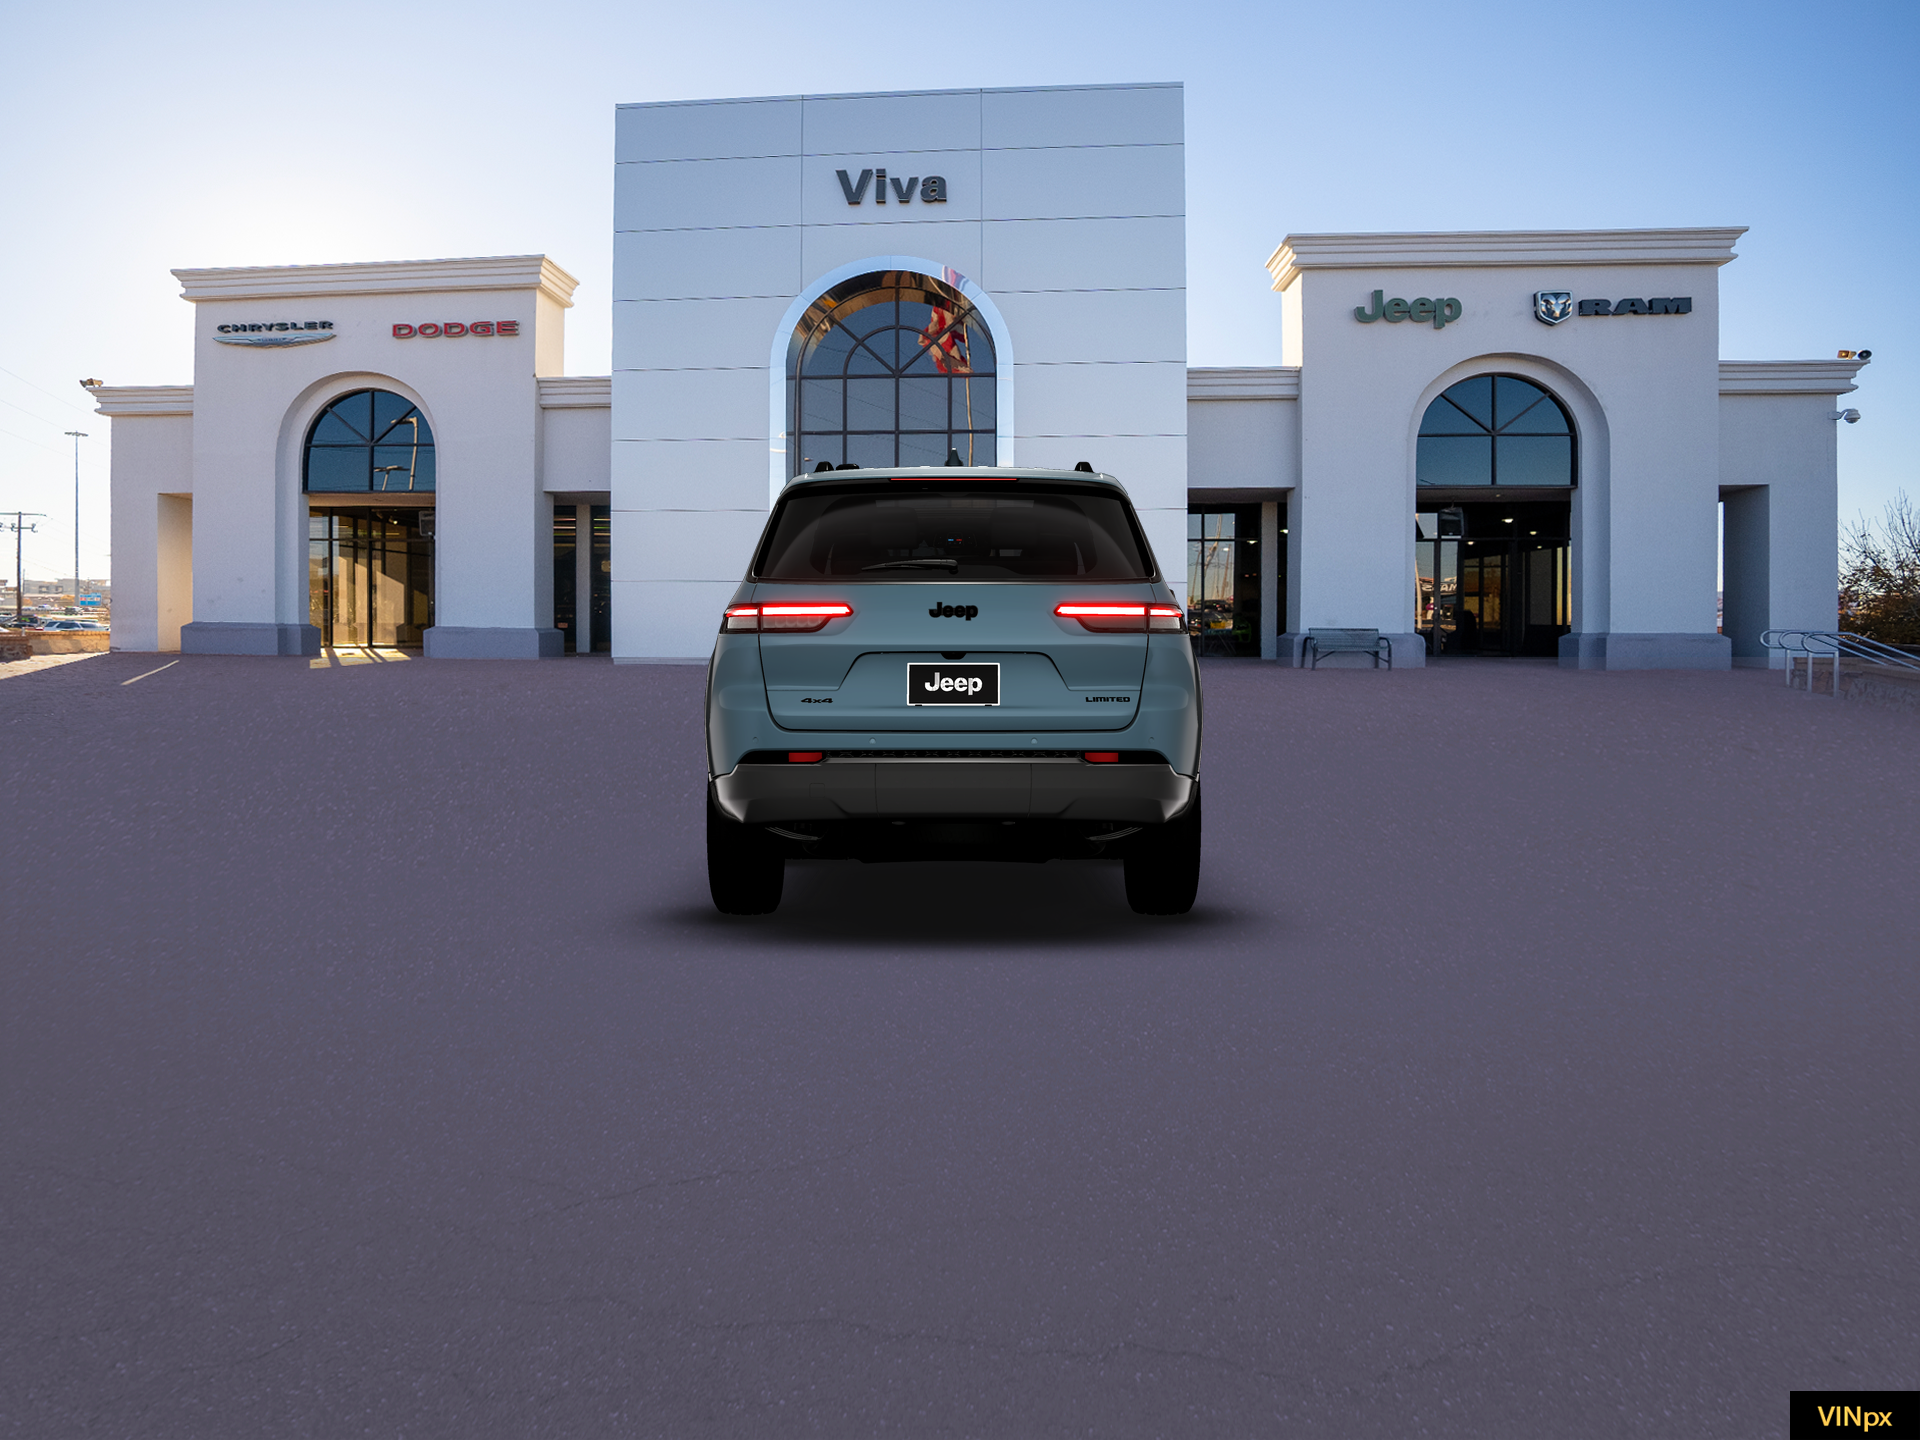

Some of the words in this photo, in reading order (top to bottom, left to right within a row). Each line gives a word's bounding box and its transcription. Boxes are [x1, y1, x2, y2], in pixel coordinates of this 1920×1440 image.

[835, 168, 947, 205] Viva
[1354, 289, 1463, 330] Jeep
[1578, 297, 1692, 316] RAM
[217, 320, 334, 334] CHRYSLER
[392, 319, 520, 339] DODGE
[928, 601, 979, 621] Jeep
[924, 671, 983, 696] Jeep
